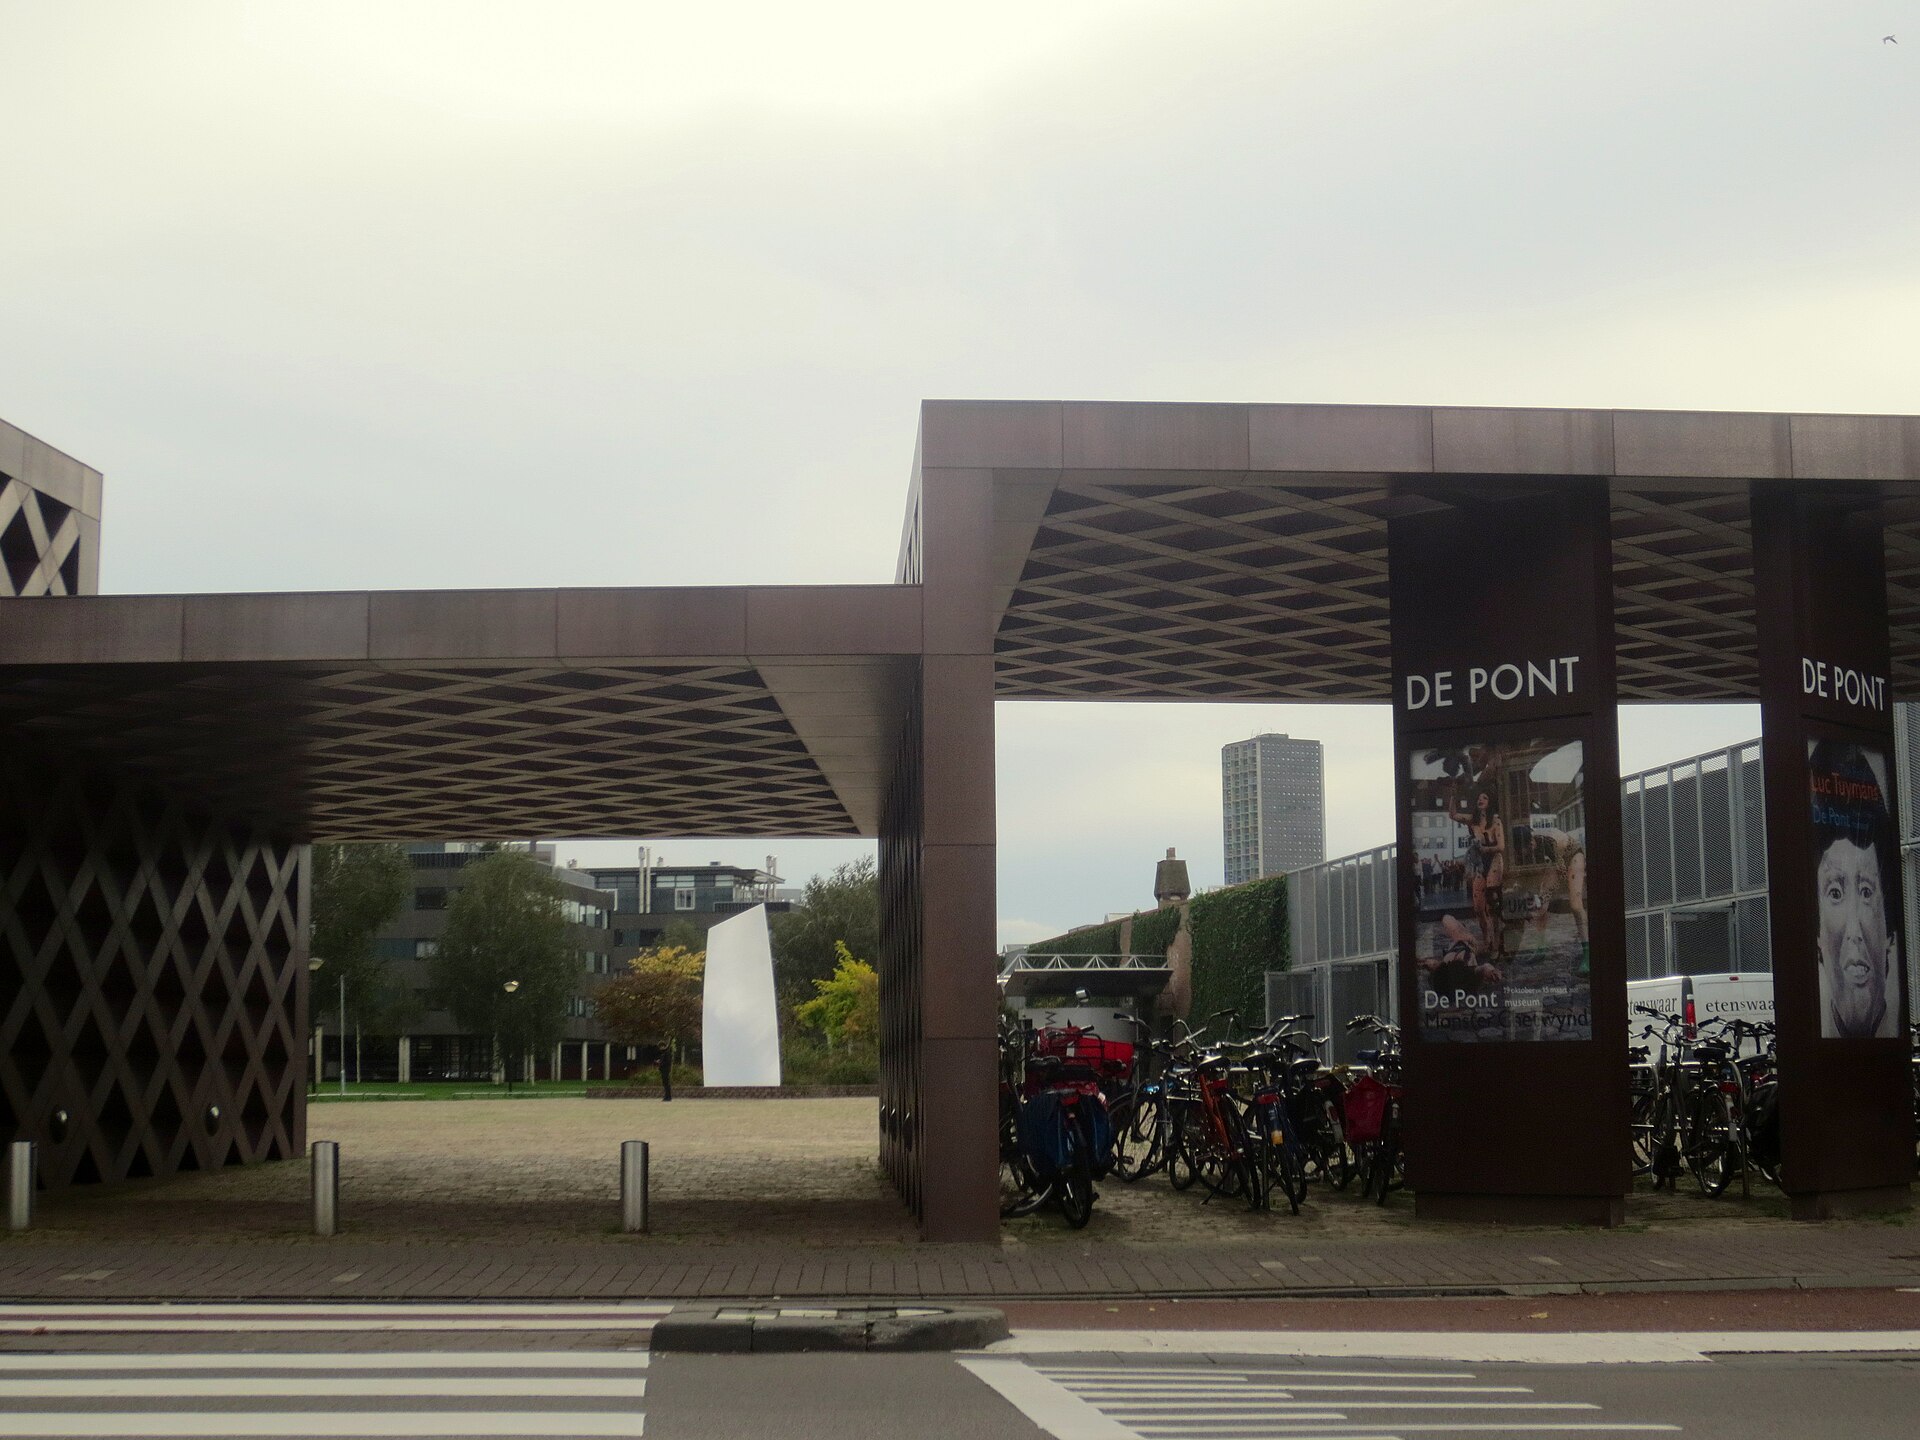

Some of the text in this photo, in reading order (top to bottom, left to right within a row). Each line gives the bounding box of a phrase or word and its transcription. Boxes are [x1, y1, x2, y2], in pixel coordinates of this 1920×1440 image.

[1406, 656, 1580, 710] DE PONT
[1802, 657, 1885, 711] DE PONT
[1811, 775, 1831, 795] Luc
[1424, 989, 1498, 1009] De Pont
[1505, 998, 1541, 1008] museum
[1628, 998, 1677, 1016] tenswaar
